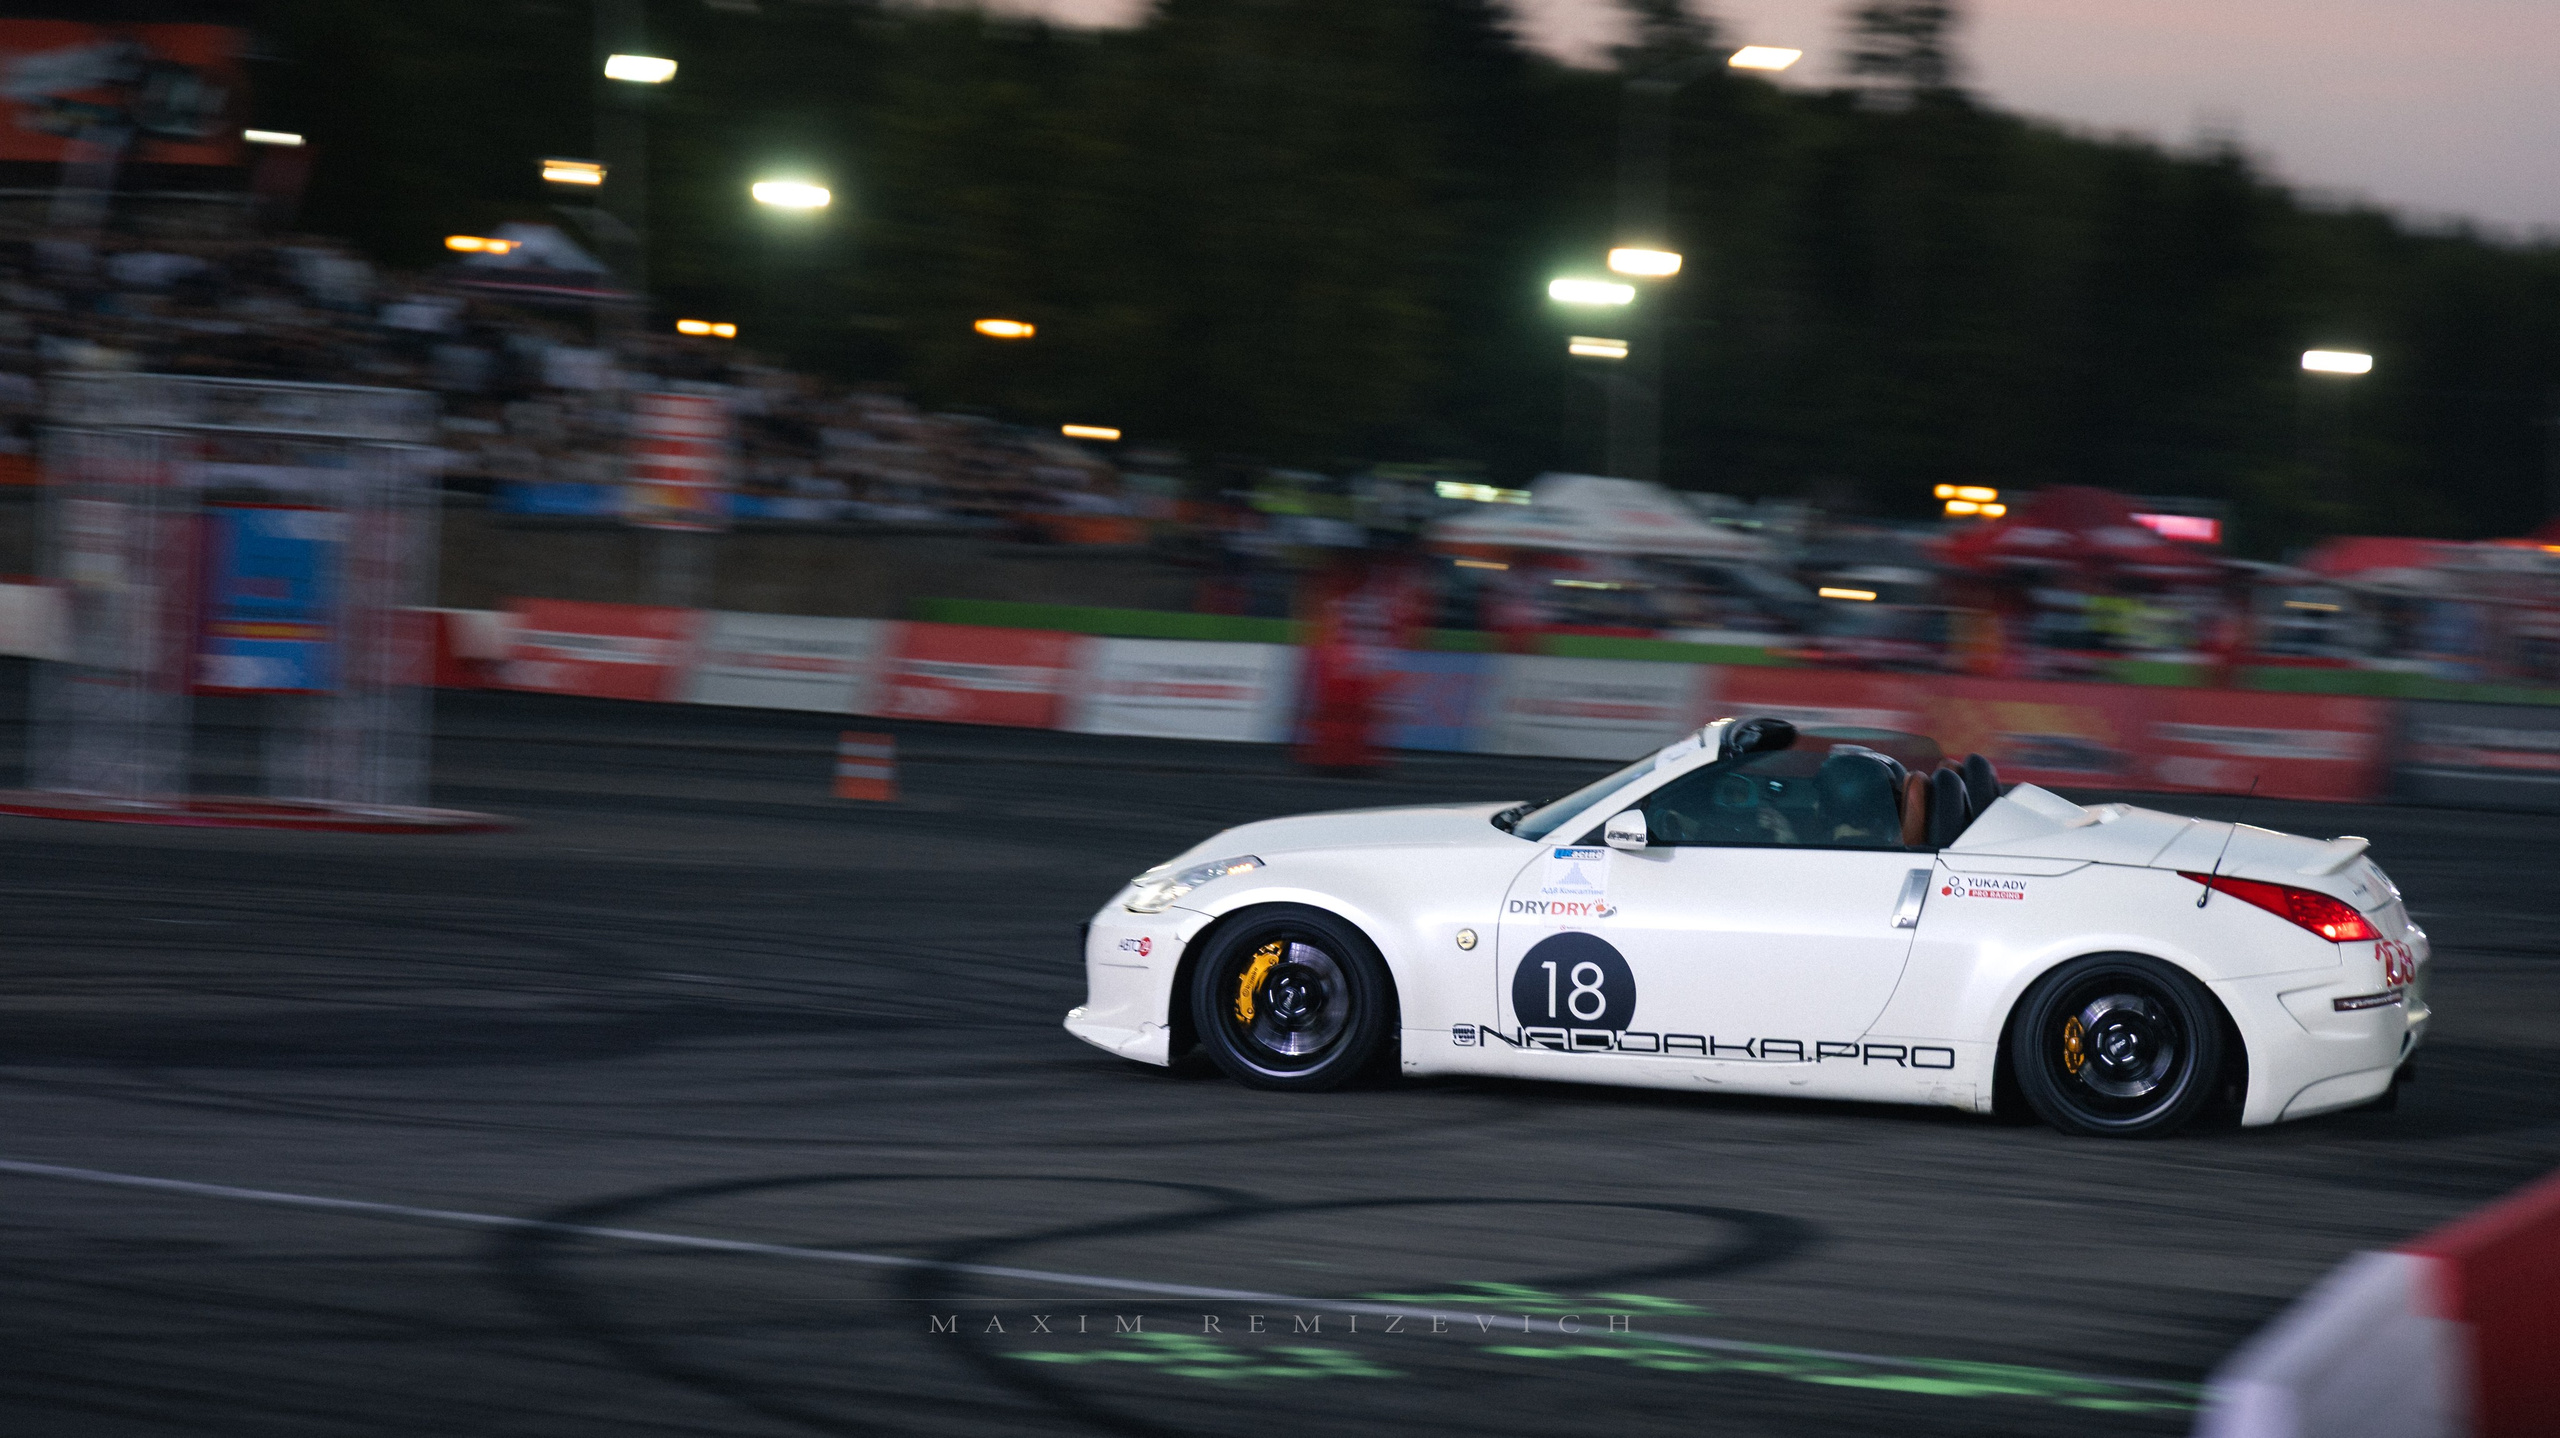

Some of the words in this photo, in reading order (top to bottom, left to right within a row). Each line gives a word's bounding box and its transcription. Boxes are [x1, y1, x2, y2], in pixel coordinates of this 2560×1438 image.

[1968, 877, 2000, 889] YUKA
[2002, 880, 2027, 890] ADV
[1972, 890, 1988, 898] PRO
[1989, 891, 2020, 899] RACING
[1541, 961, 1607, 1022] 18
